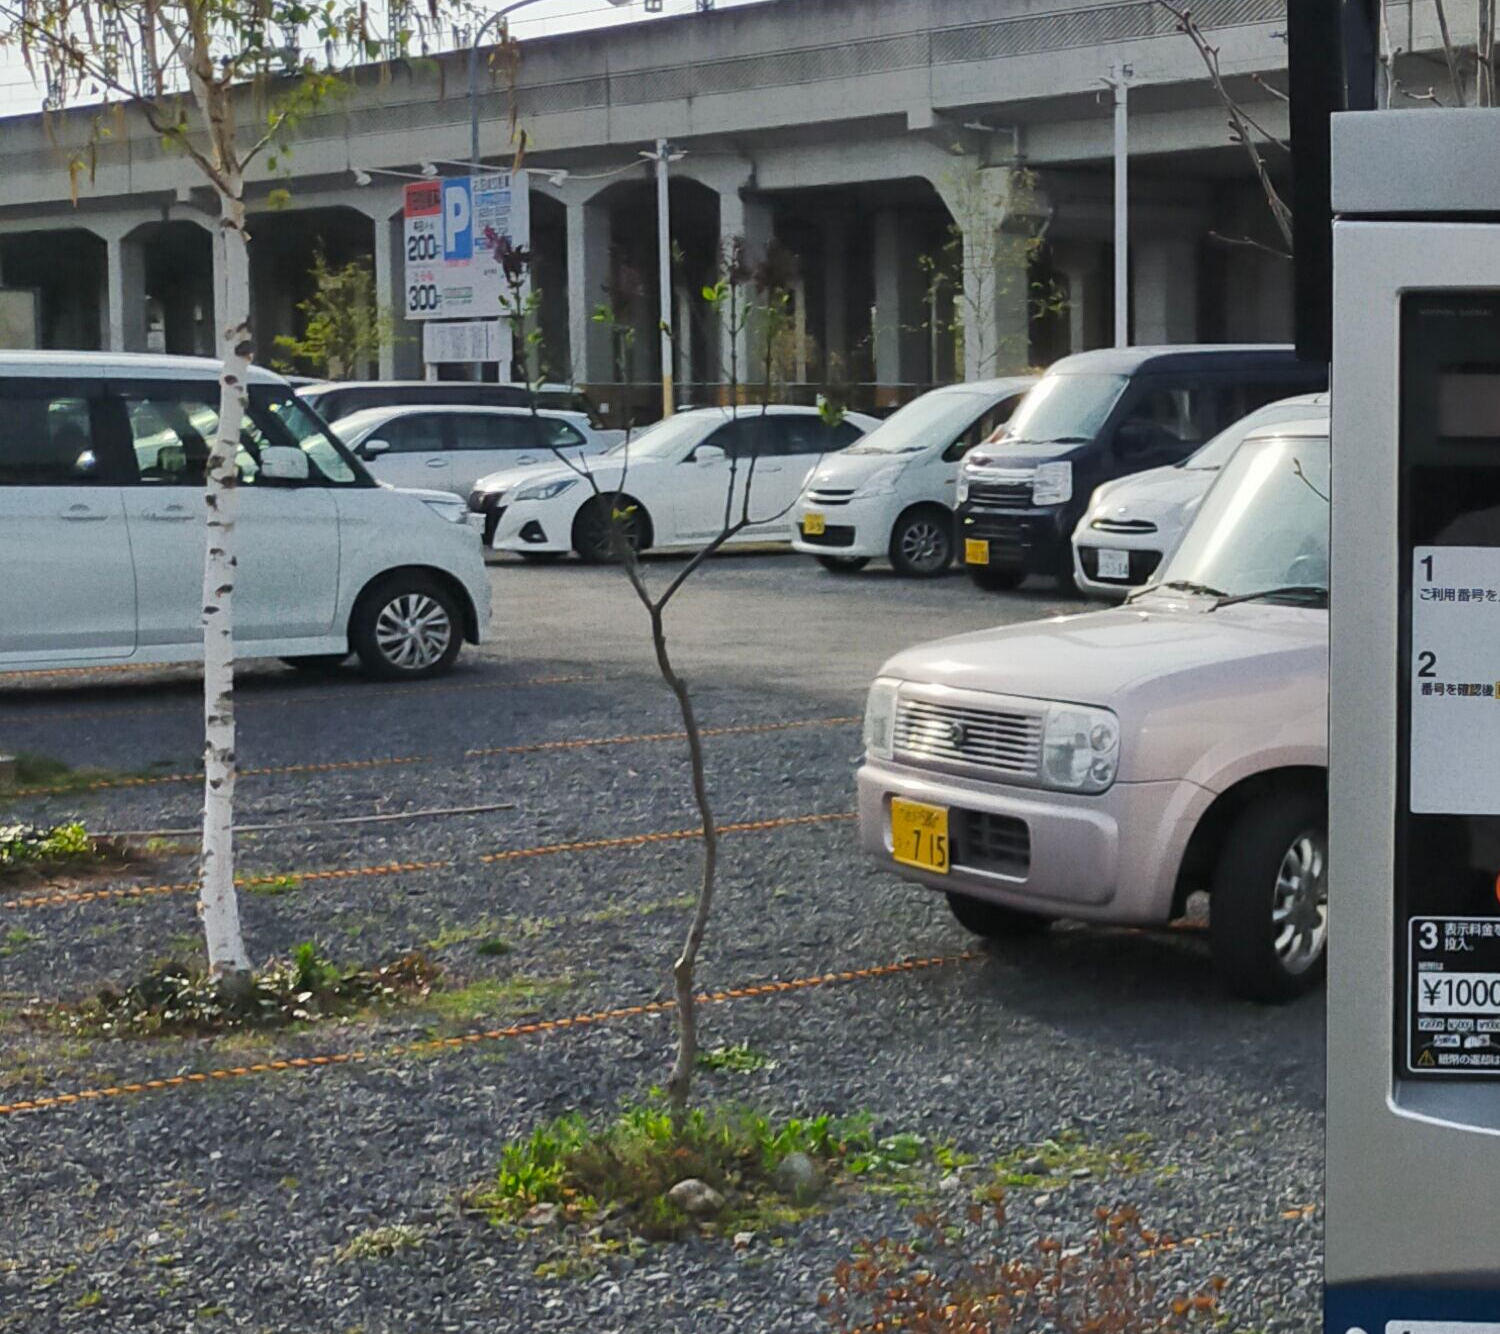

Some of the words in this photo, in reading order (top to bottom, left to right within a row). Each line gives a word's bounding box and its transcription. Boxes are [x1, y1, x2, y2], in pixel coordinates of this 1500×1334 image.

[445, 186, 470, 253] P
[1420, 555, 1433, 582] 1
[1418, 651, 1437, 677] 2
[1419, 922, 1438, 950] 3
